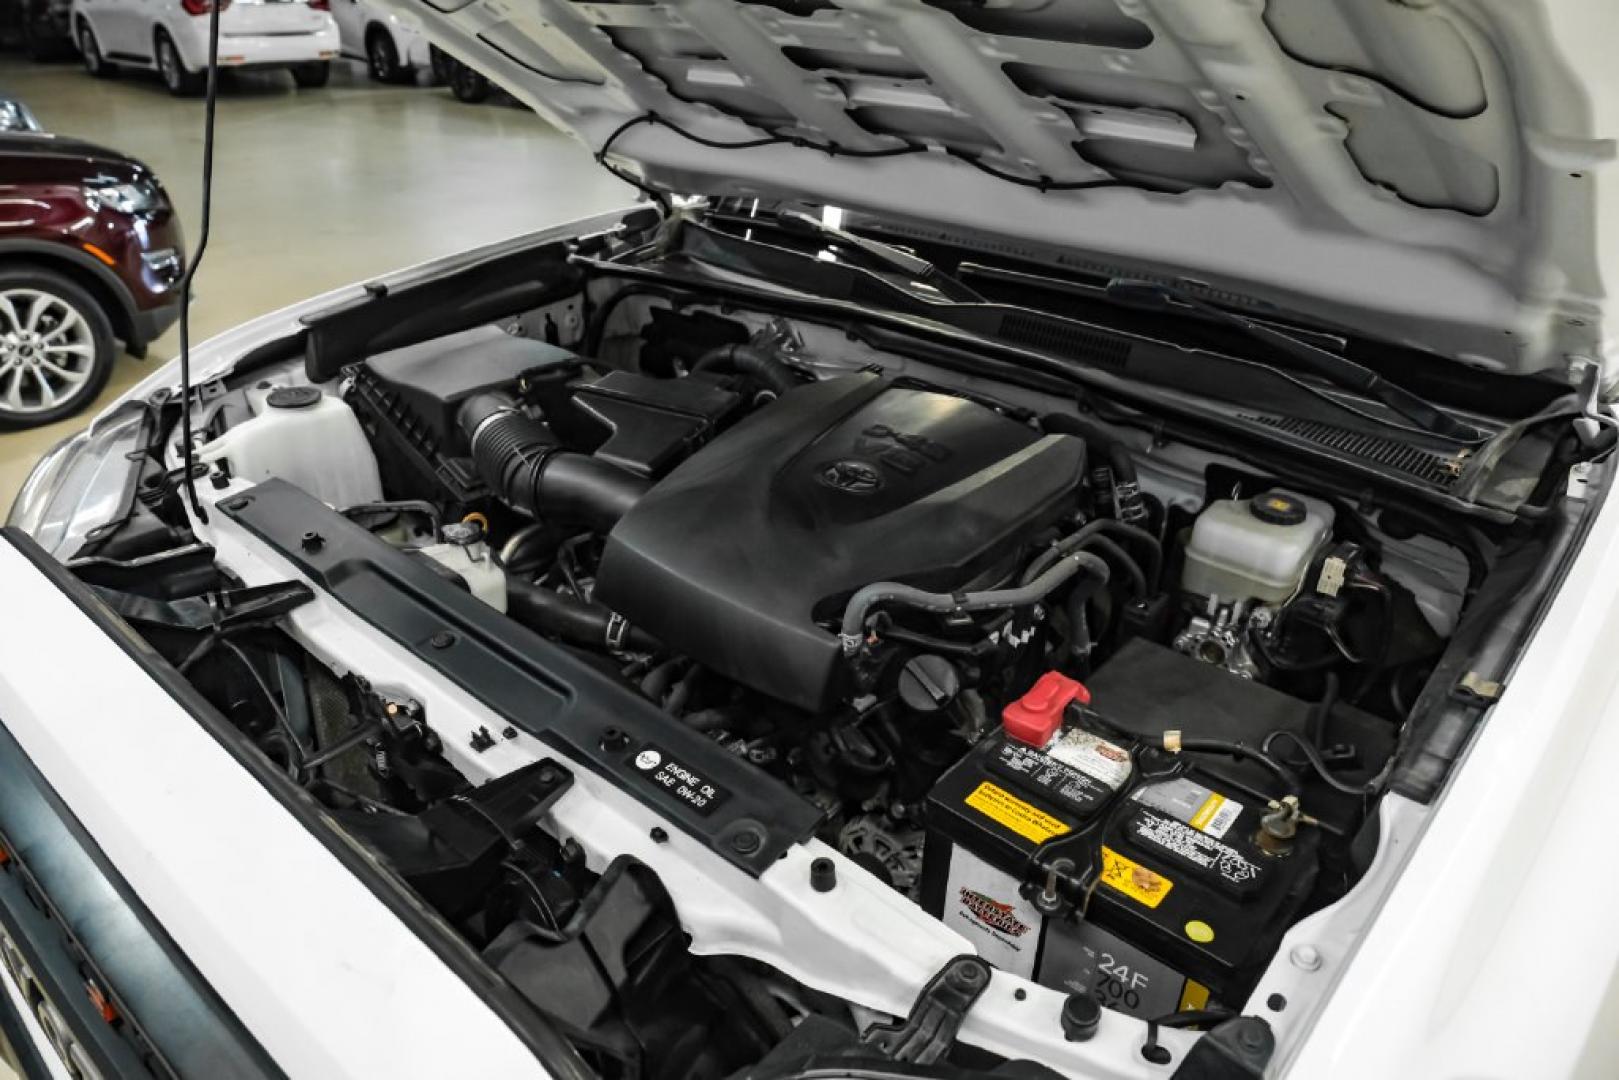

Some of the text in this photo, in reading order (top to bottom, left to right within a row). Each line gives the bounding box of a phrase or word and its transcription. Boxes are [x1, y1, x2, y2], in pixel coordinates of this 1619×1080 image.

[655, 771, 708, 807] SAE 0W-20
[664, 762, 715, 799] ENGINE OIL
[1098, 953, 1149, 989] 24F
[1096, 970, 1140, 1010] 700
